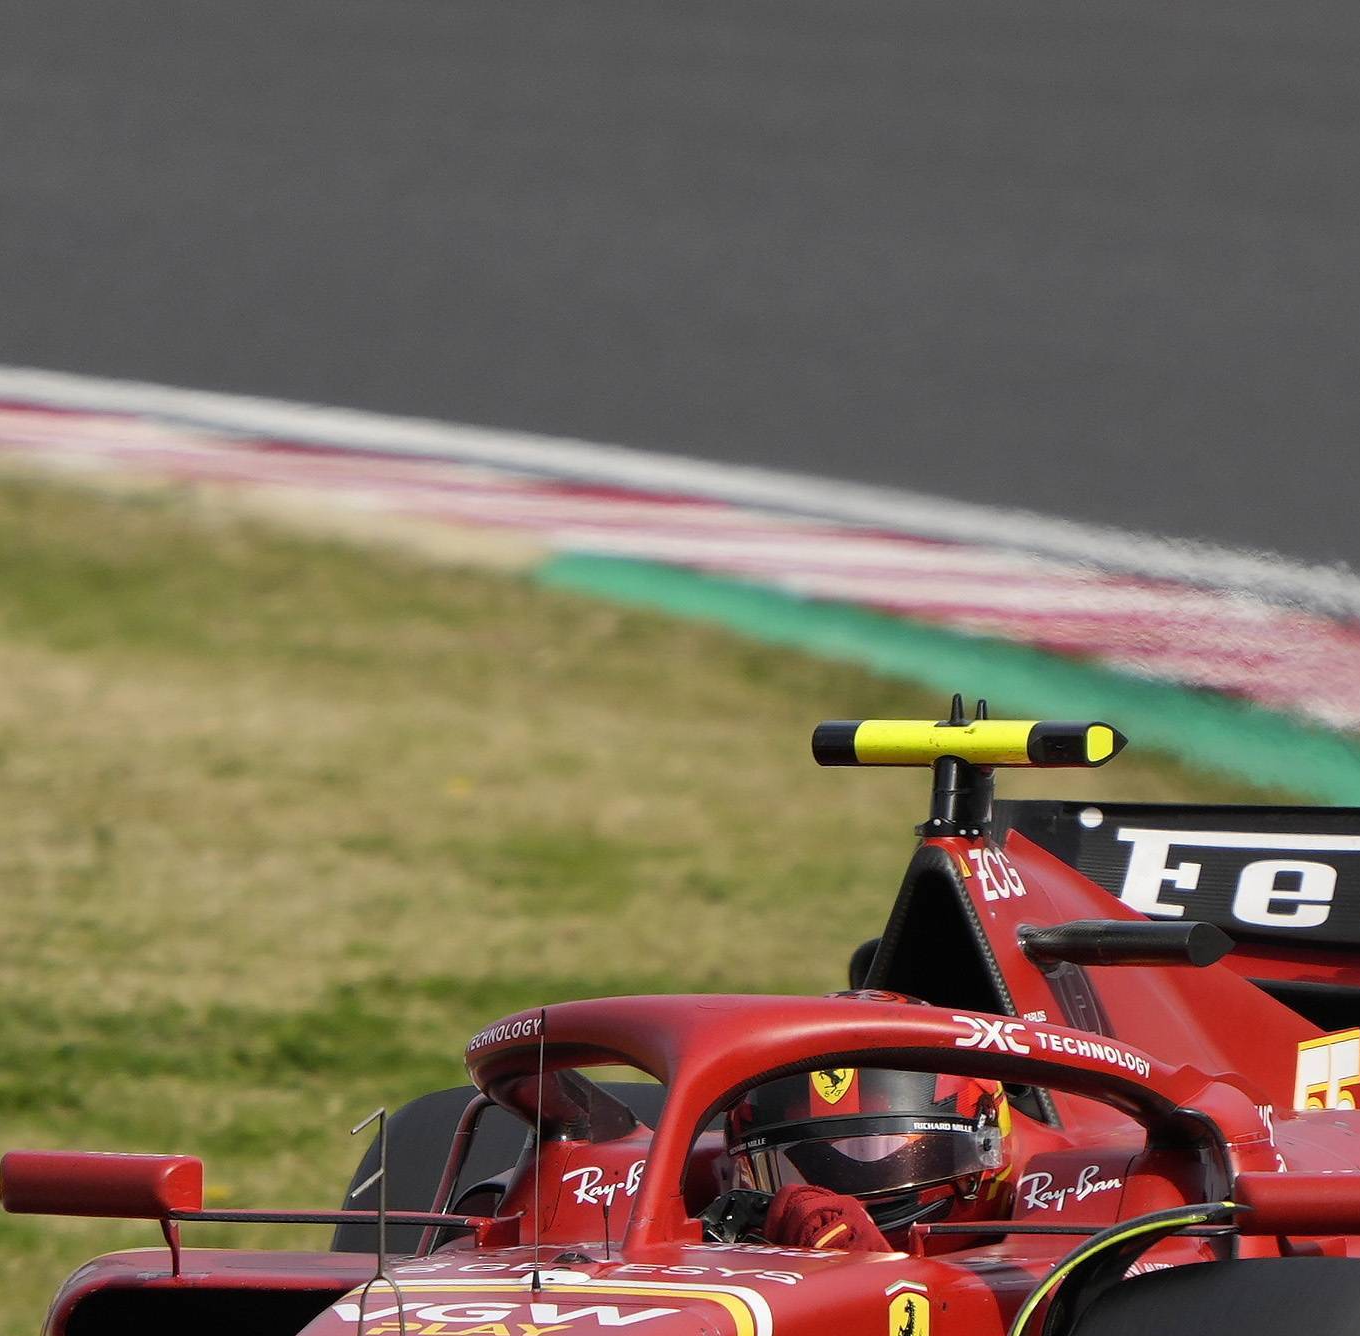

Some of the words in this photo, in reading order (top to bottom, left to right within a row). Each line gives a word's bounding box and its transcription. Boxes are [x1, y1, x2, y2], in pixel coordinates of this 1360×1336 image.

[468, 1018, 542, 1051] ECHNOLOGY
[952, 1015, 1030, 1054] DXC
[1035, 1031, 1151, 1078] TECHNOLOGY
[562, 1160, 645, 1206] Ray-B
[1017, 1165, 1122, 1211] Ray-Ban
[457, 1262, 804, 1285] GEESYS
[331, 1302, 681, 1327] VGW
